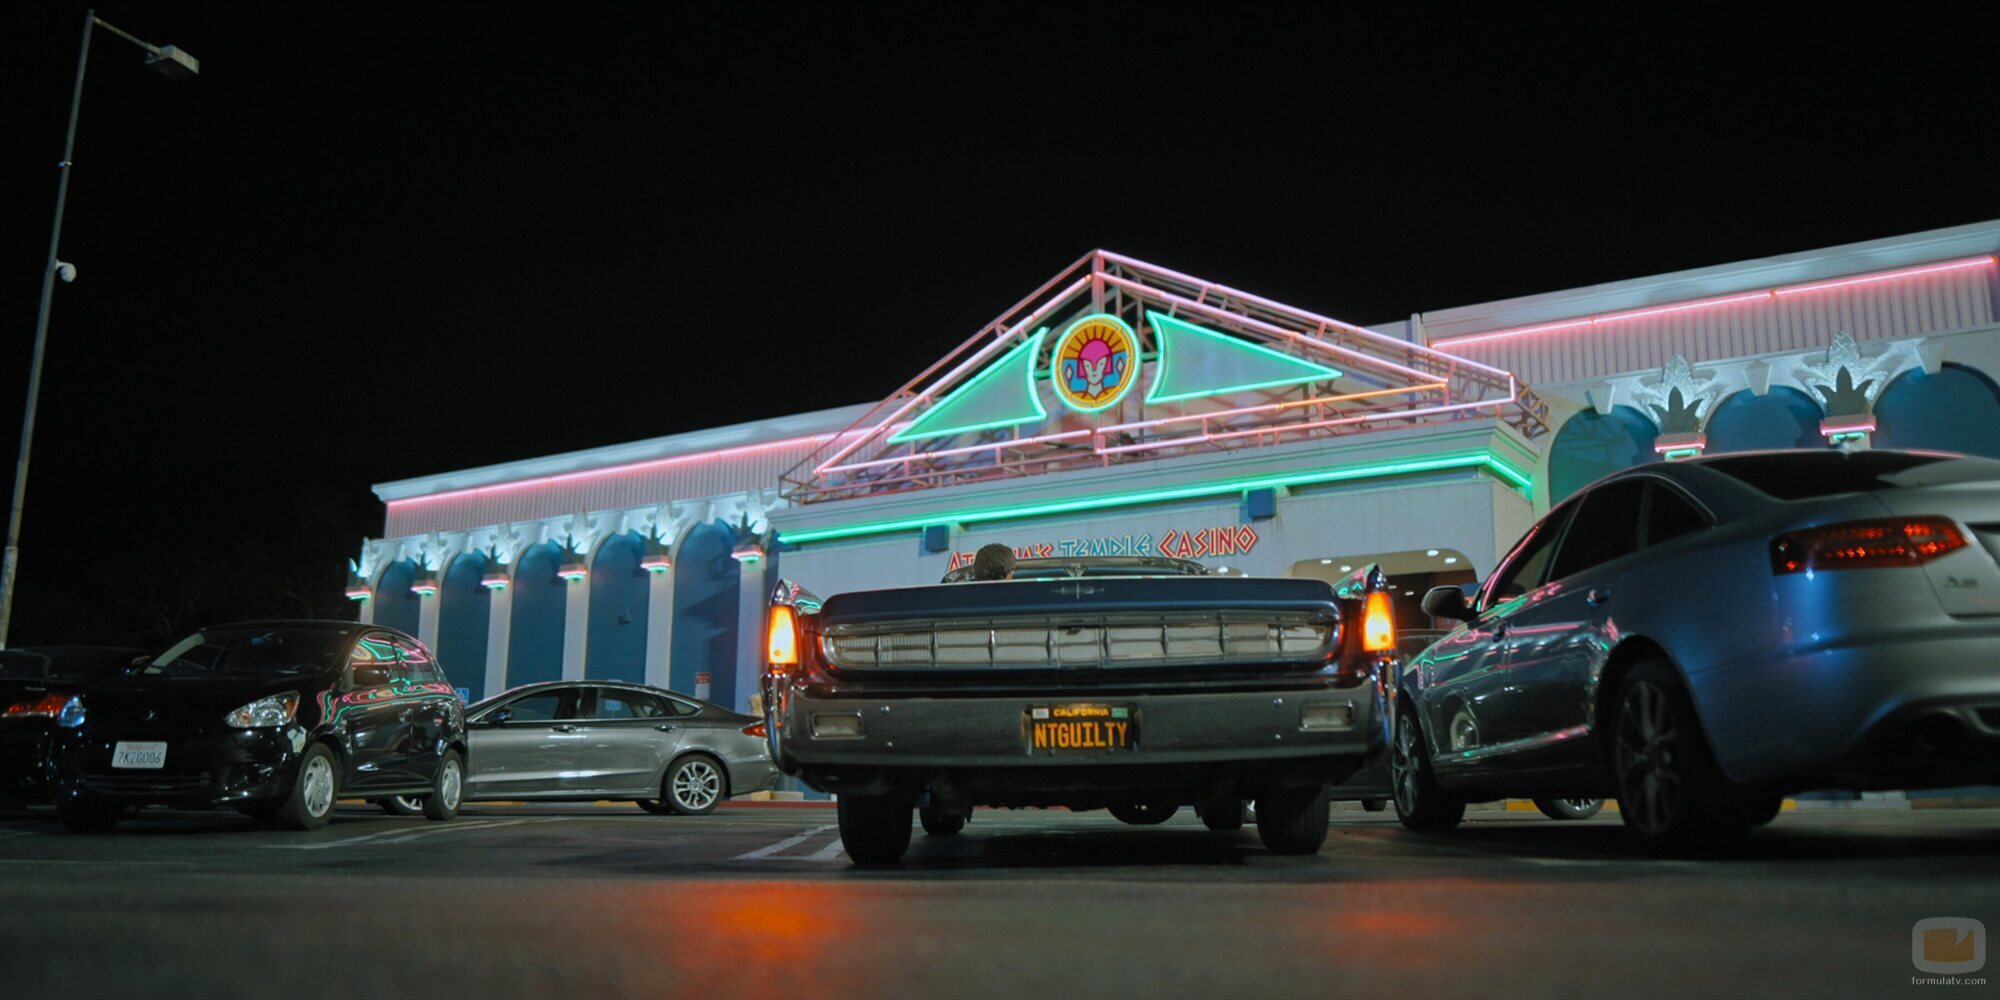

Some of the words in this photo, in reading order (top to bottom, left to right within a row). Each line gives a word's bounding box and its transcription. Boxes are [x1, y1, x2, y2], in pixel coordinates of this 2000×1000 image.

[947, 543, 1054, 573] ATA'S
[1157, 524, 1259, 559] CASINO
[1053, 707, 1110, 717] CALIFORNIA
[1034, 721, 1127, 748] NTGUILTY
